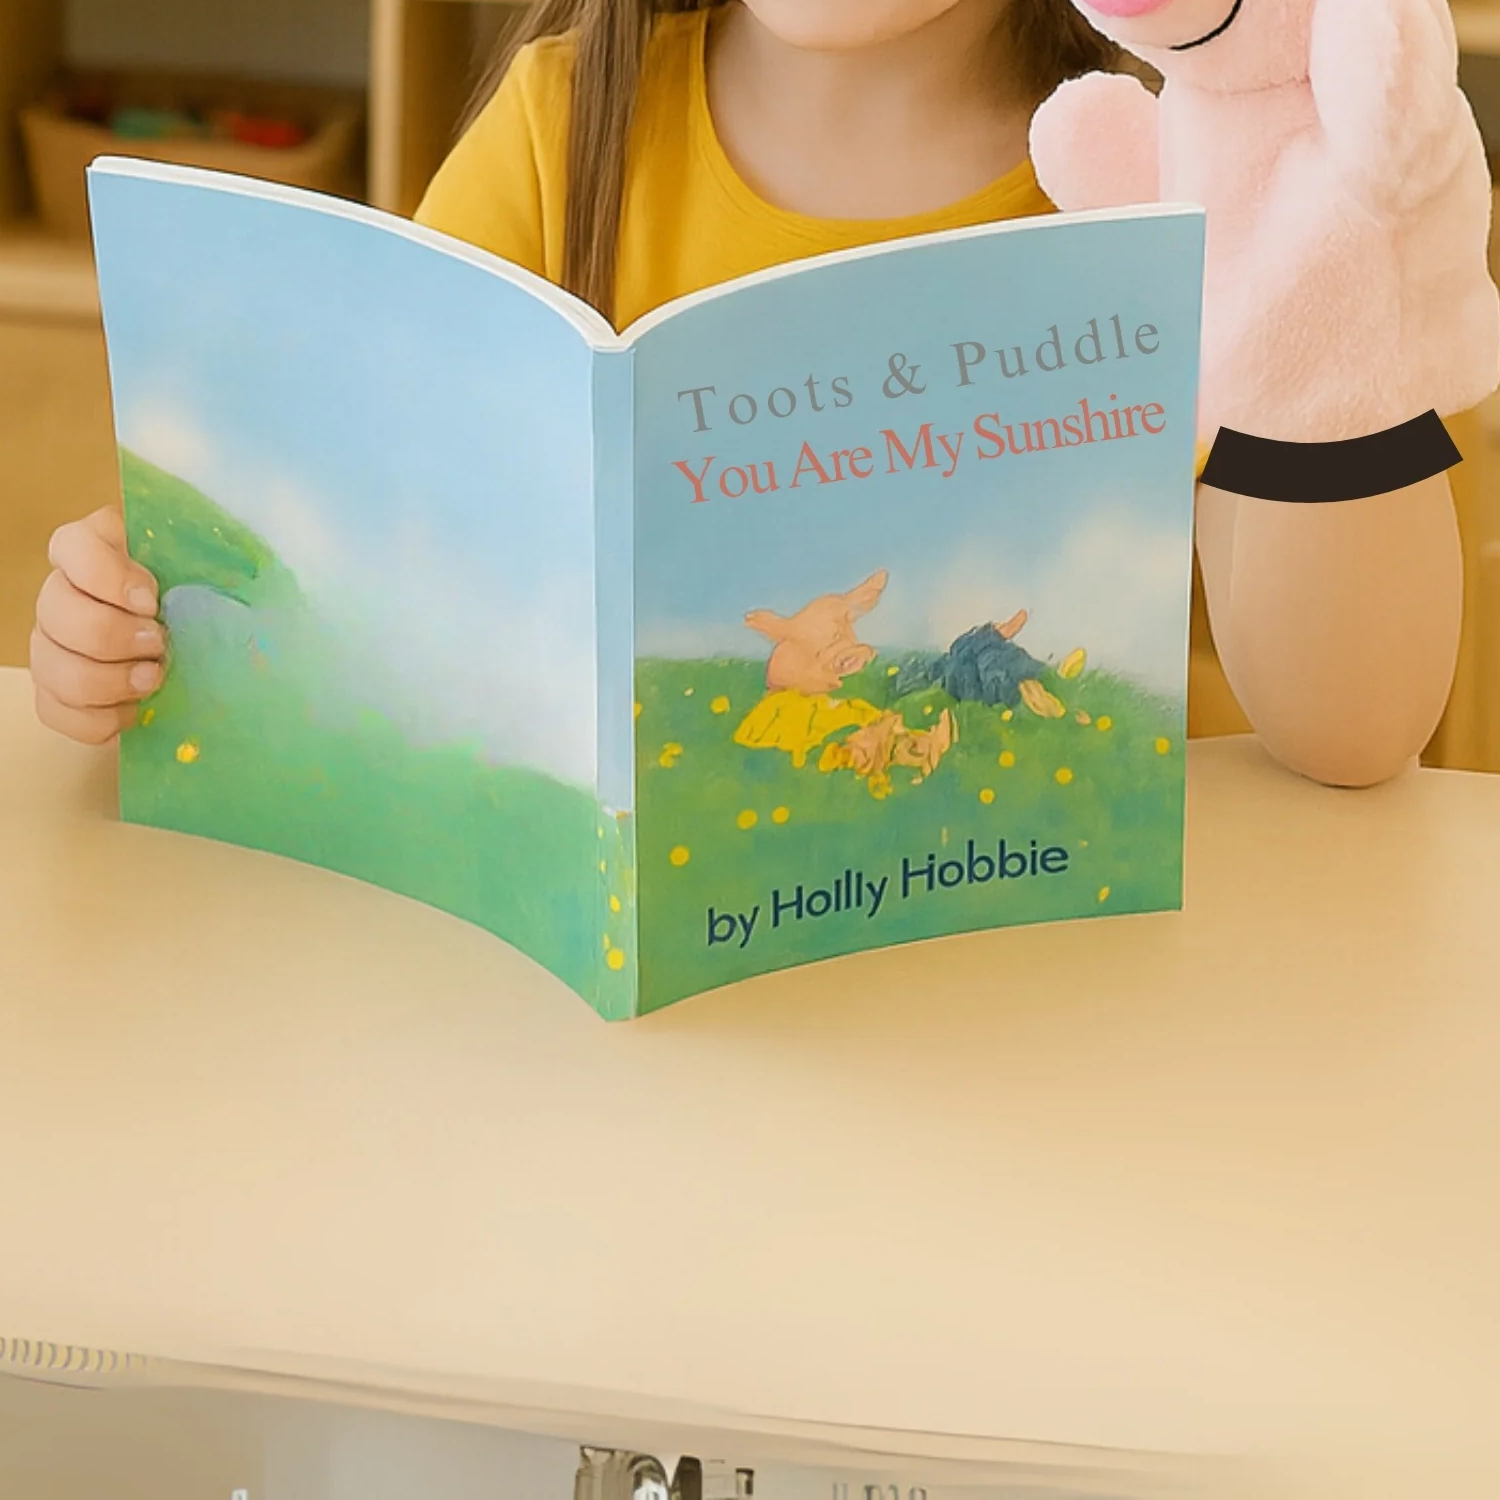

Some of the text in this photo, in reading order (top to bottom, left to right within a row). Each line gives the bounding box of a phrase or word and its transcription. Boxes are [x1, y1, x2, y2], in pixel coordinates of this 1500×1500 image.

[677, 313, 1160, 433] Toots & Puddle
[671, 456, 781, 504] You
[788, 440, 875, 489] Are
[878, 422, 965, 478] My
[707, 905, 760, 949] by
[901, 838, 1070, 899] Hobbie
